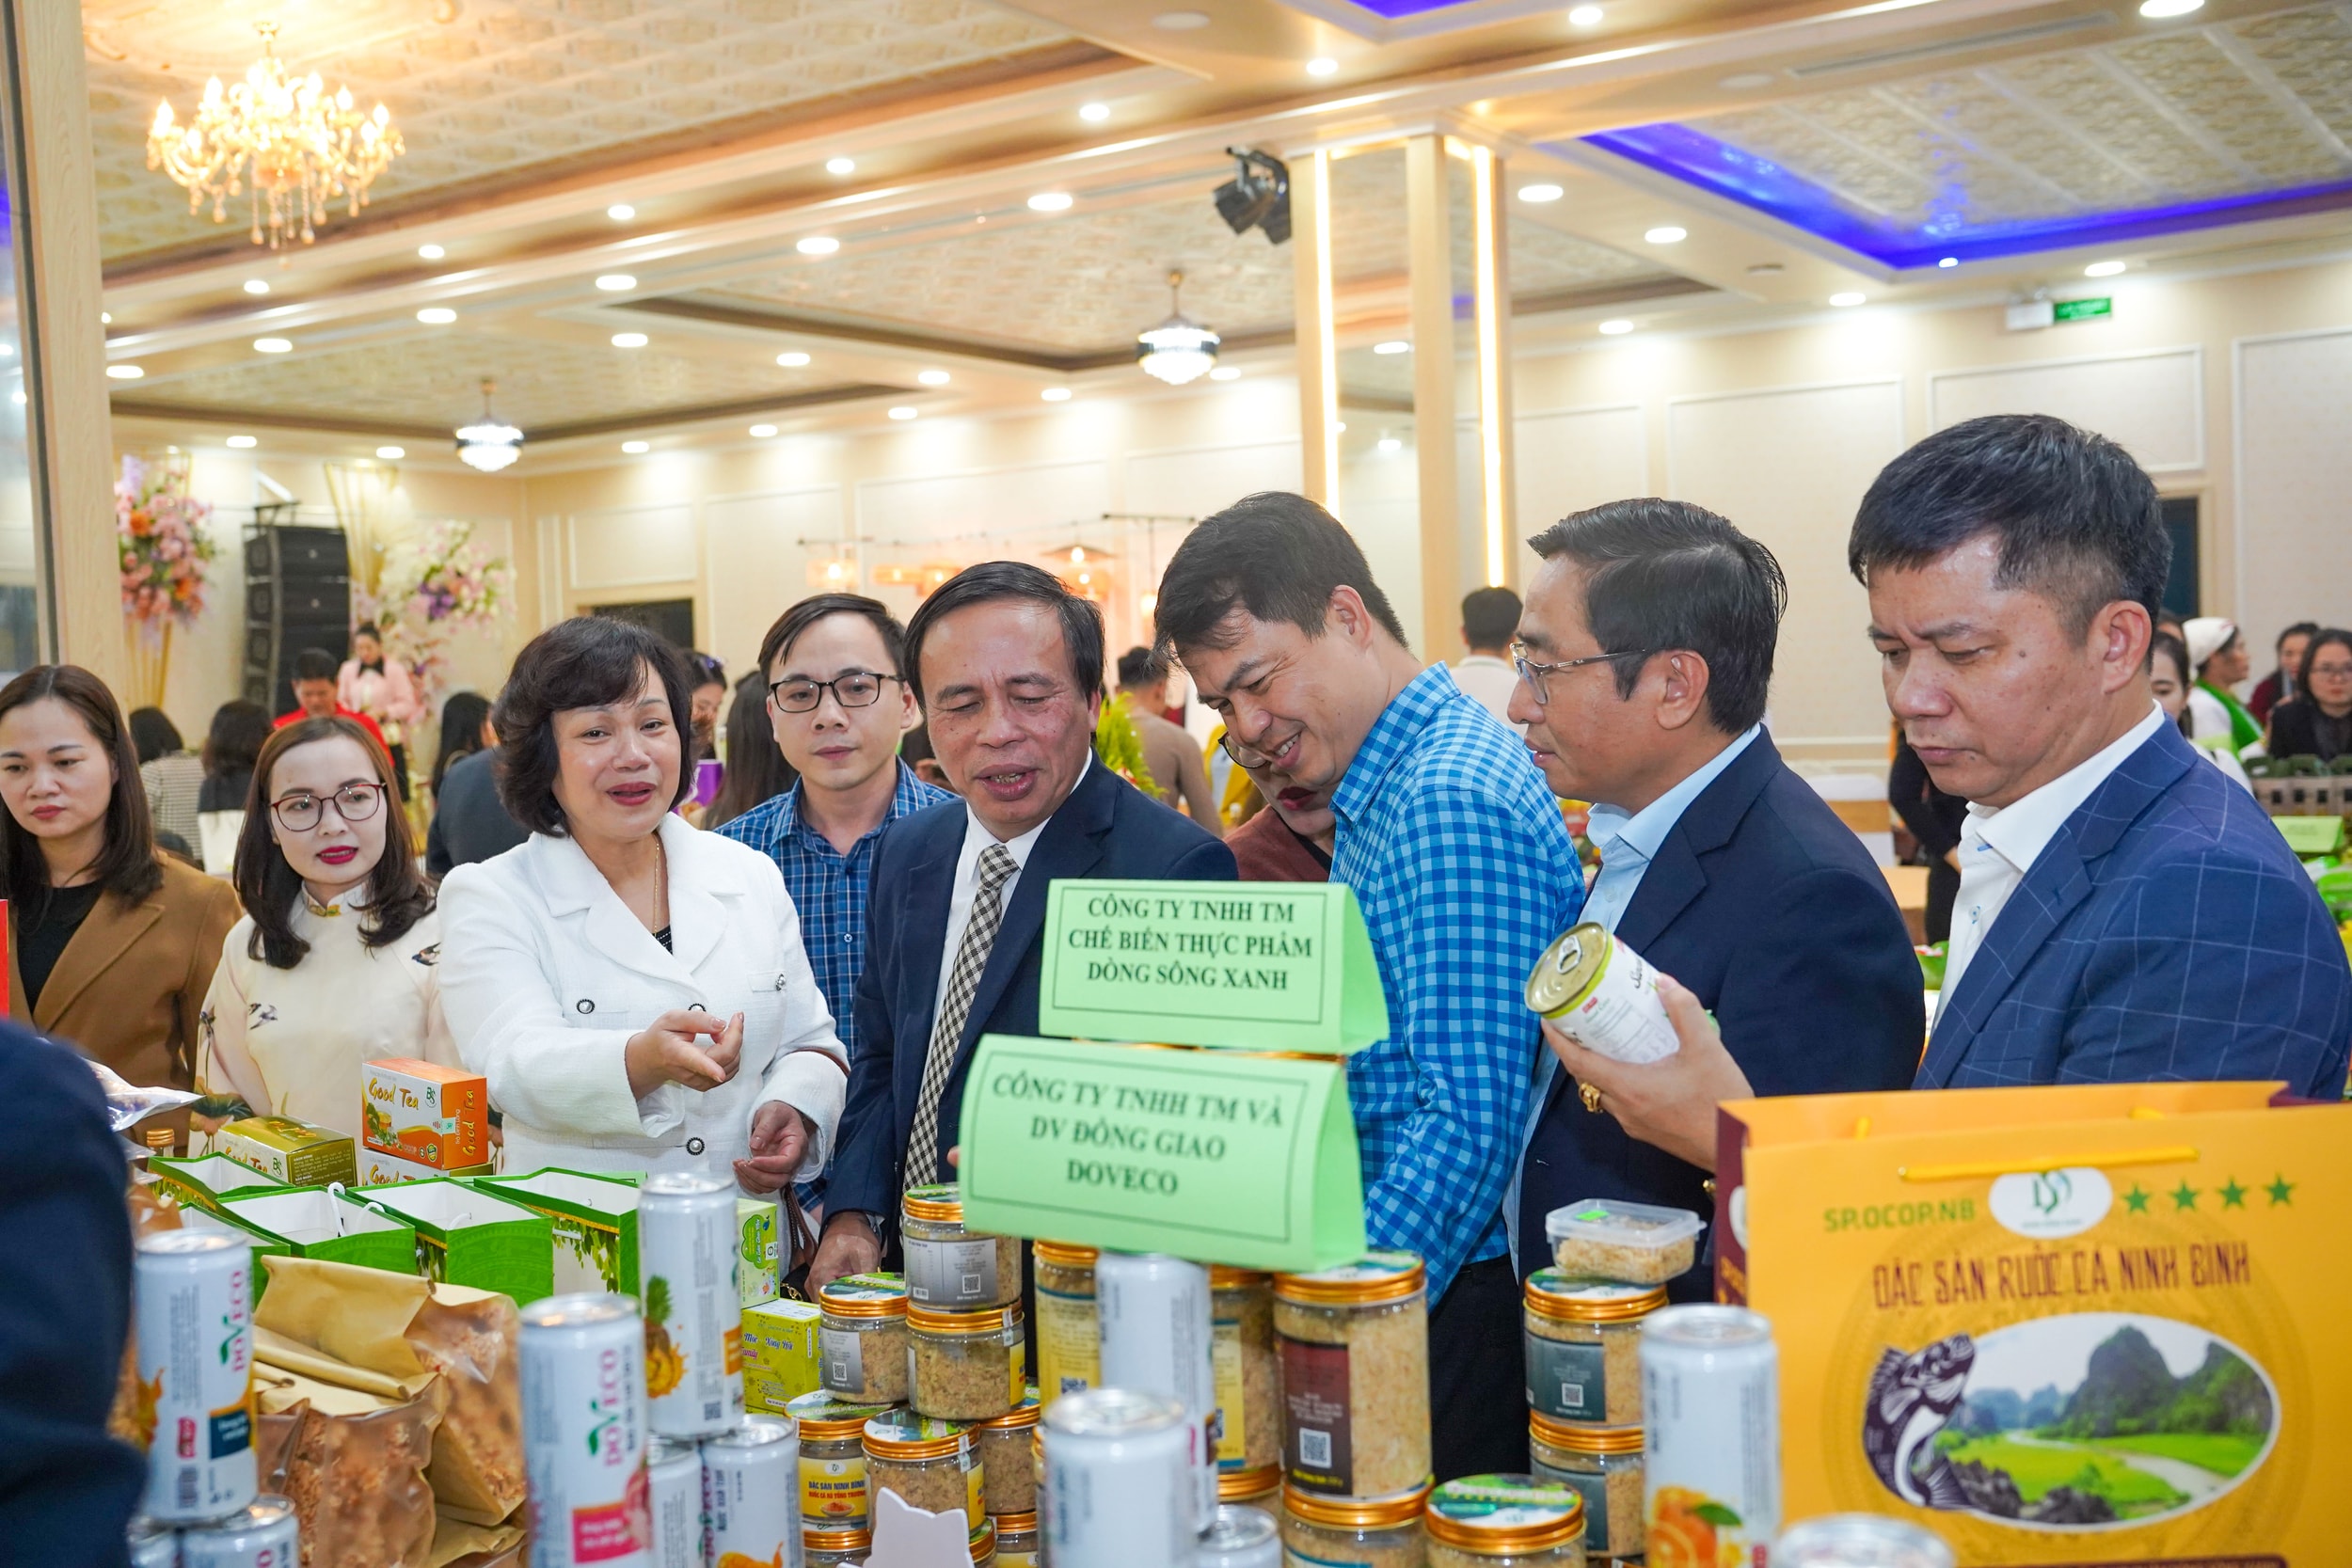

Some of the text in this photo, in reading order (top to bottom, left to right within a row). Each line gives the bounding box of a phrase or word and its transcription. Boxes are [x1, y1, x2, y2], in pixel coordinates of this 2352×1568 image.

[1089, 894, 1295, 923] CÔNG TY TNHH TM
[1069, 926, 1312, 958] CHẾ BIẾN THỰC PHẨM
[1088, 958, 1288, 990] DÒNG SÔNG XANH
[368, 1078, 419, 1110] Good Tea
[992, 1070, 1285, 1129] CÔNG TY TNHH TM VÀ
[462, 1089, 476, 1157] Good Tea
[1029, 1115, 1227, 1162] DV ĐỒNG GIAO
[1067, 1158, 1179, 1196] DOVECO
[1872, 1257, 1923, 1315] ĐẶC
[1933, 1249, 1986, 1306] SẢN
[2120, 1244, 2181, 1291] NINH
[2189, 1235, 2251, 1288] BÌNH
[219, 1271, 245, 1372] DOVECO
[588, 1349, 625, 1467] DOVECO
